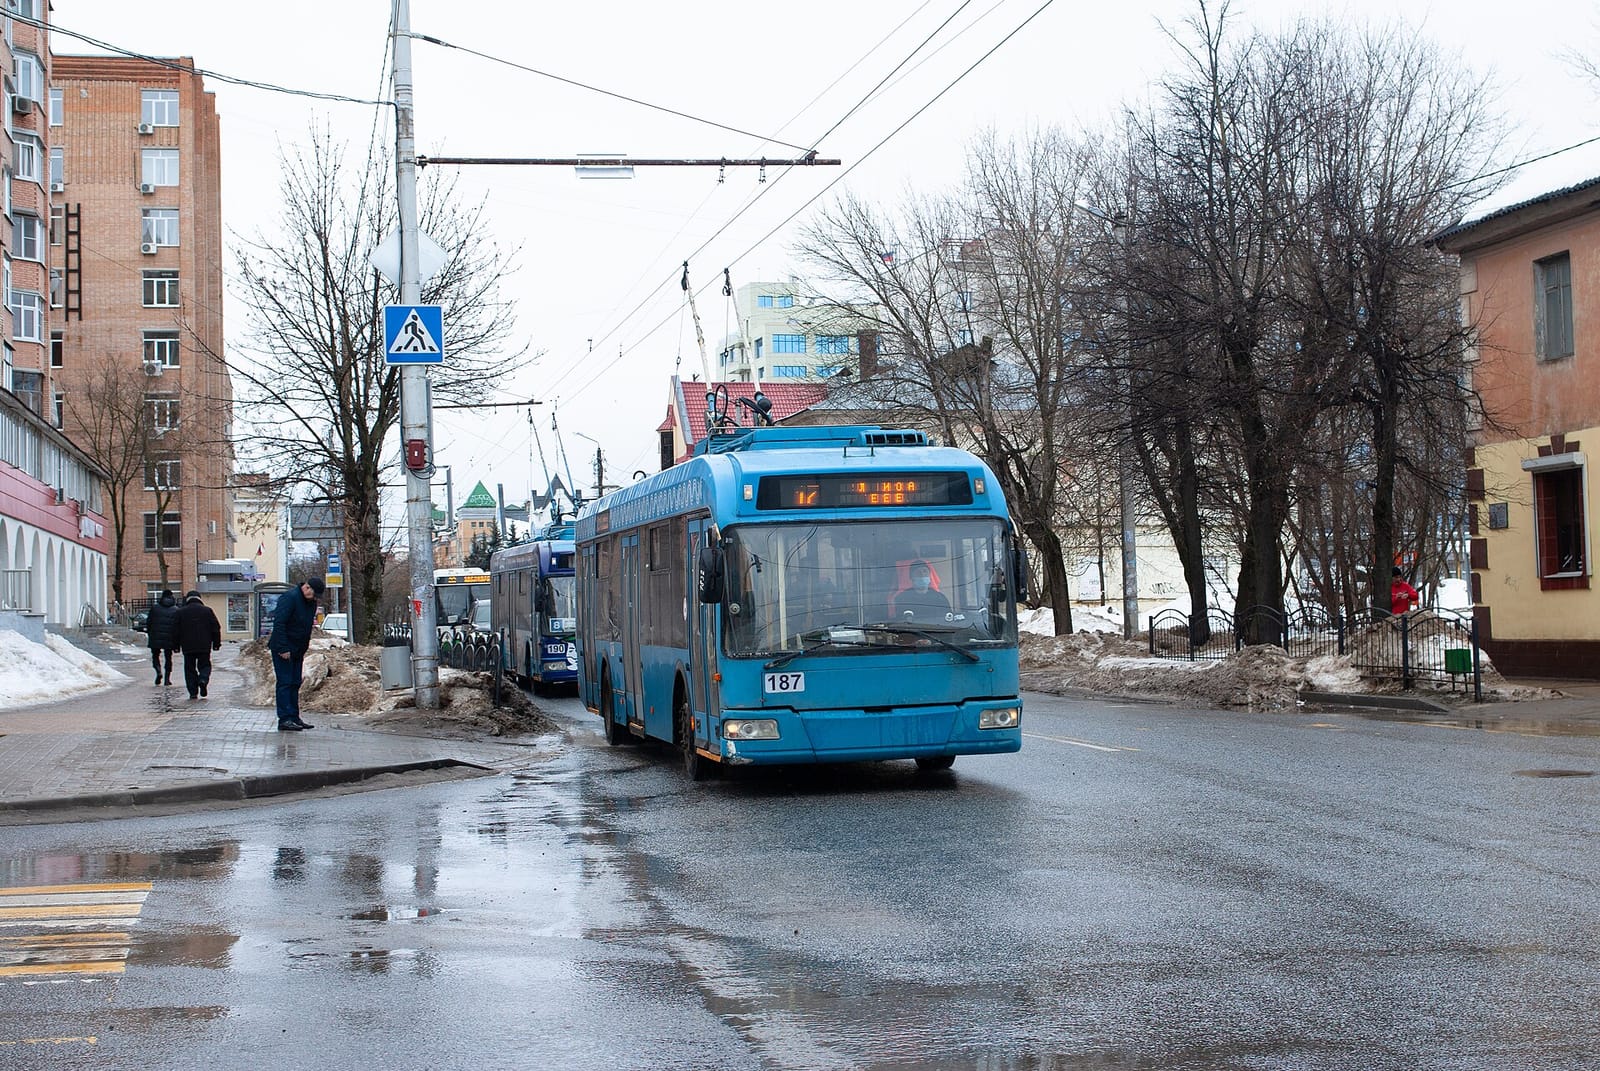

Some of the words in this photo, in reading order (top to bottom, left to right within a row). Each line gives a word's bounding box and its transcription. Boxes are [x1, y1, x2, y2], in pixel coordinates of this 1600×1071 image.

[553, 621, 561, 629] 8
[549, 645, 565, 653] 190
[767, 674, 802, 691] 187
